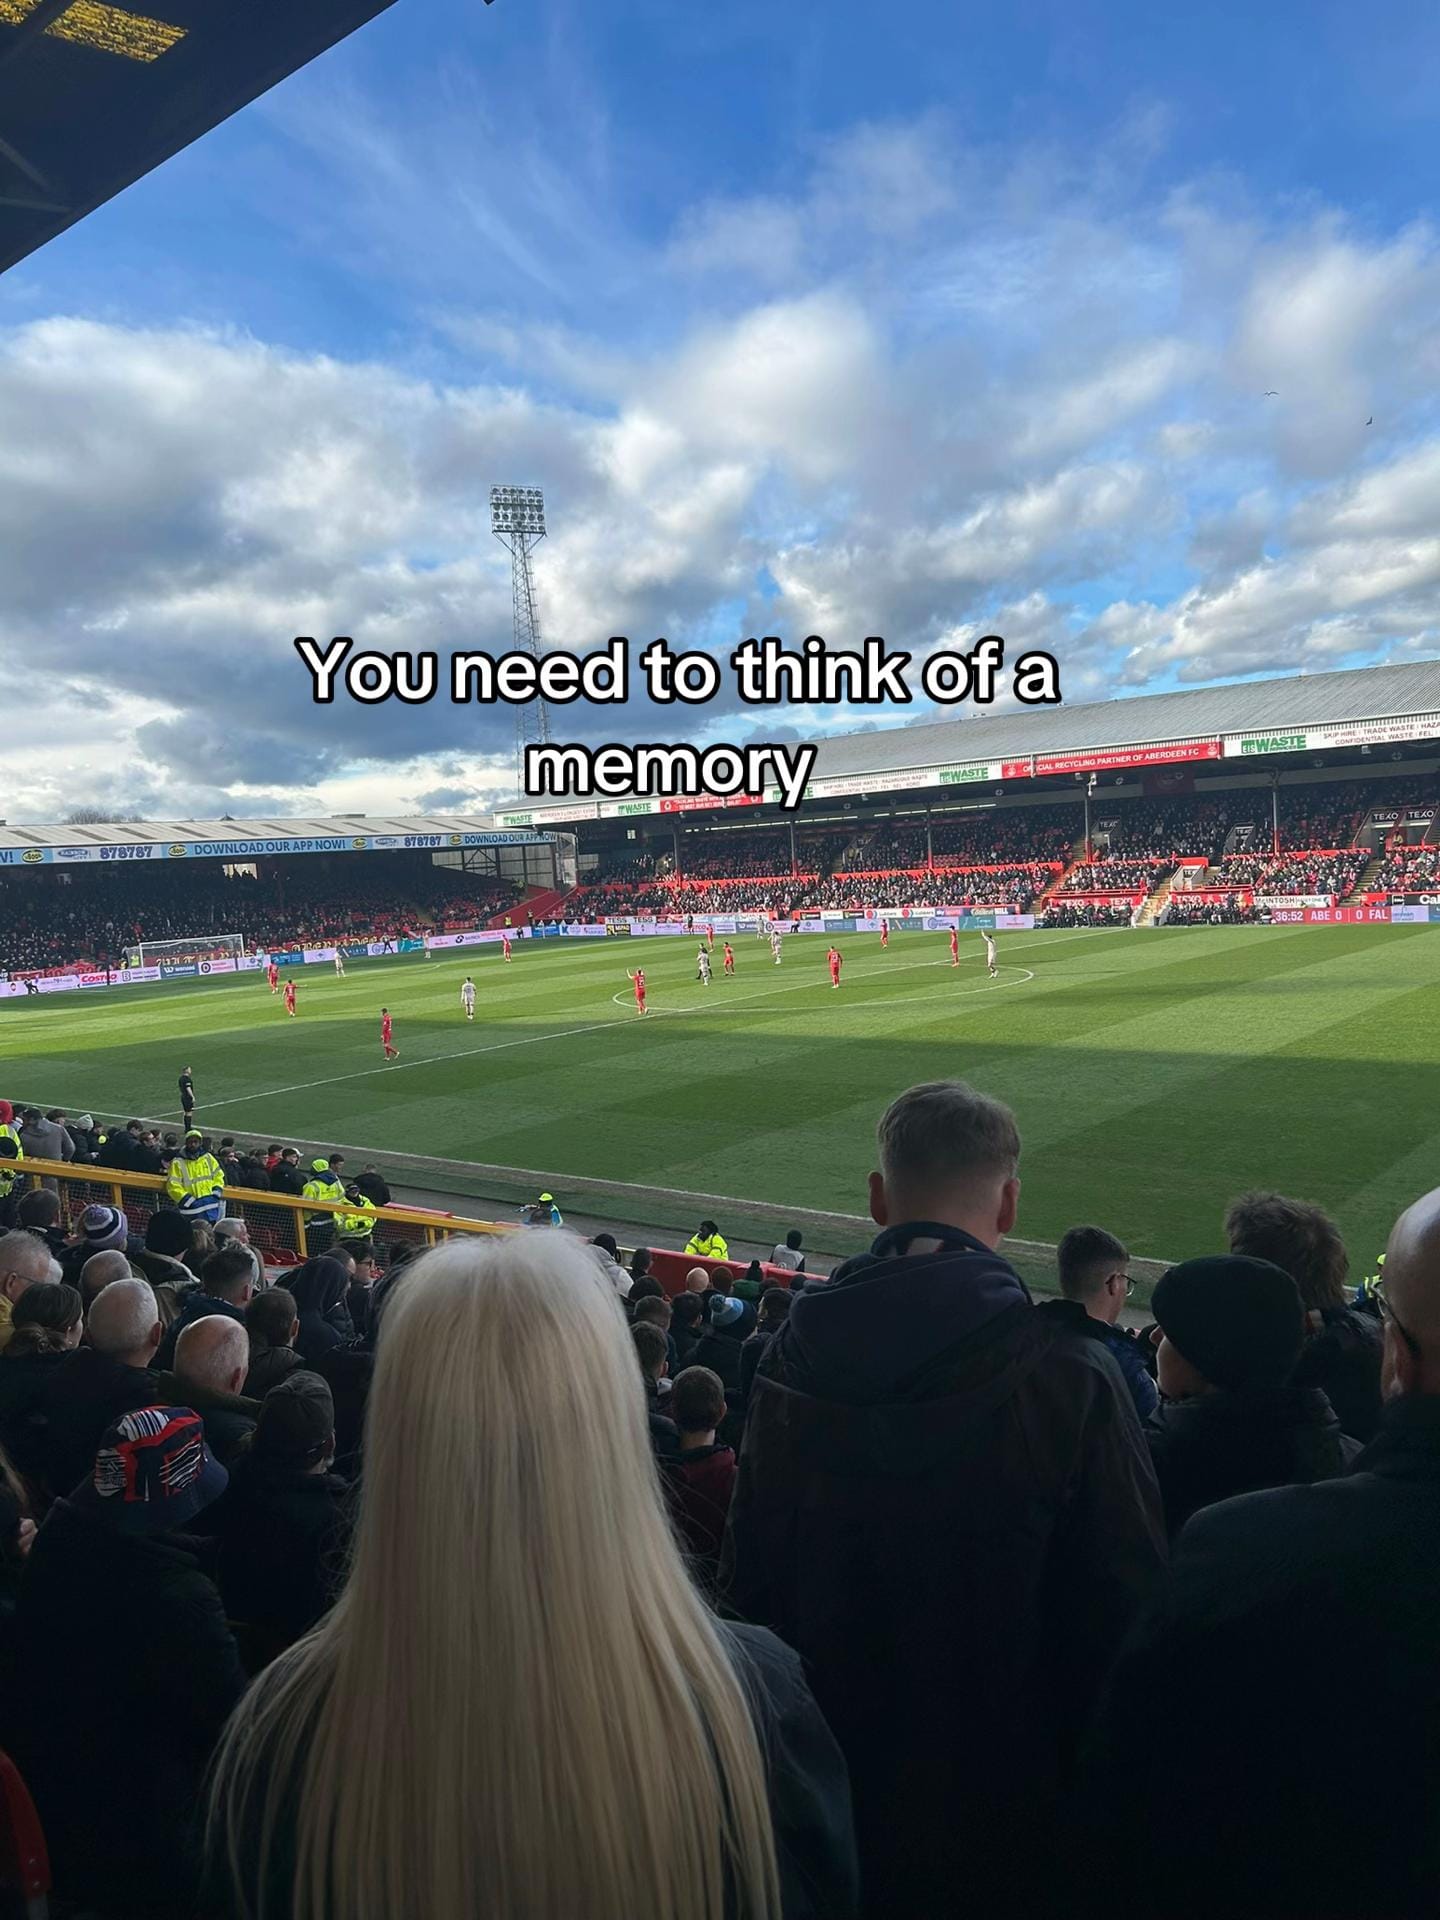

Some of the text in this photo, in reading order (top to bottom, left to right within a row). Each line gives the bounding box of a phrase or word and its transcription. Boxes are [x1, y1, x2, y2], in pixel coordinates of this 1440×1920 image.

[1323, 732, 1340, 740] SKIP
[1340, 730, 1357, 738] HIRE
[1363, 728, 1388, 736] TRADE
[1389, 725, 1415, 733] WASTE
[1335, 736, 1386, 746] CONFIDENTIAL
[1388, 732, 1414, 741] WASTE
[1256, 735, 1307, 753] WASTE
[1022, 747, 1200, 774] OFCIAL RECYCLING PARTNER OF ABERDEEN FC
[950, 767, 989, 783] WASTE
[625, 803, 652, 814] WASTE
[1409, 810, 1434, 819] TEXO
[510, 814, 533, 825] WASTE
[1374, 812, 1399, 820] TEXO
[404, 836, 442, 848] 878787
[464, 834, 508, 844] DOWNLOAD
[509, 833, 525, 843] OUR
[100, 846, 153, 861] 878787
[194, 841, 265, 856] DOWNLOAD
[266, 840, 291, 853] OUR
[294, 838, 314, 851] APP
[317, 838, 346, 851] NOW!
[1275, 911, 1303, 922] 36:52
[1310, 910, 1330, 921] ABE
[1335, 910, 1342, 921] 0
[1356, 910, 1363, 920] 0
[1369, 909, 1389, 920] FAL
[81, 973, 118, 983] COSTO
